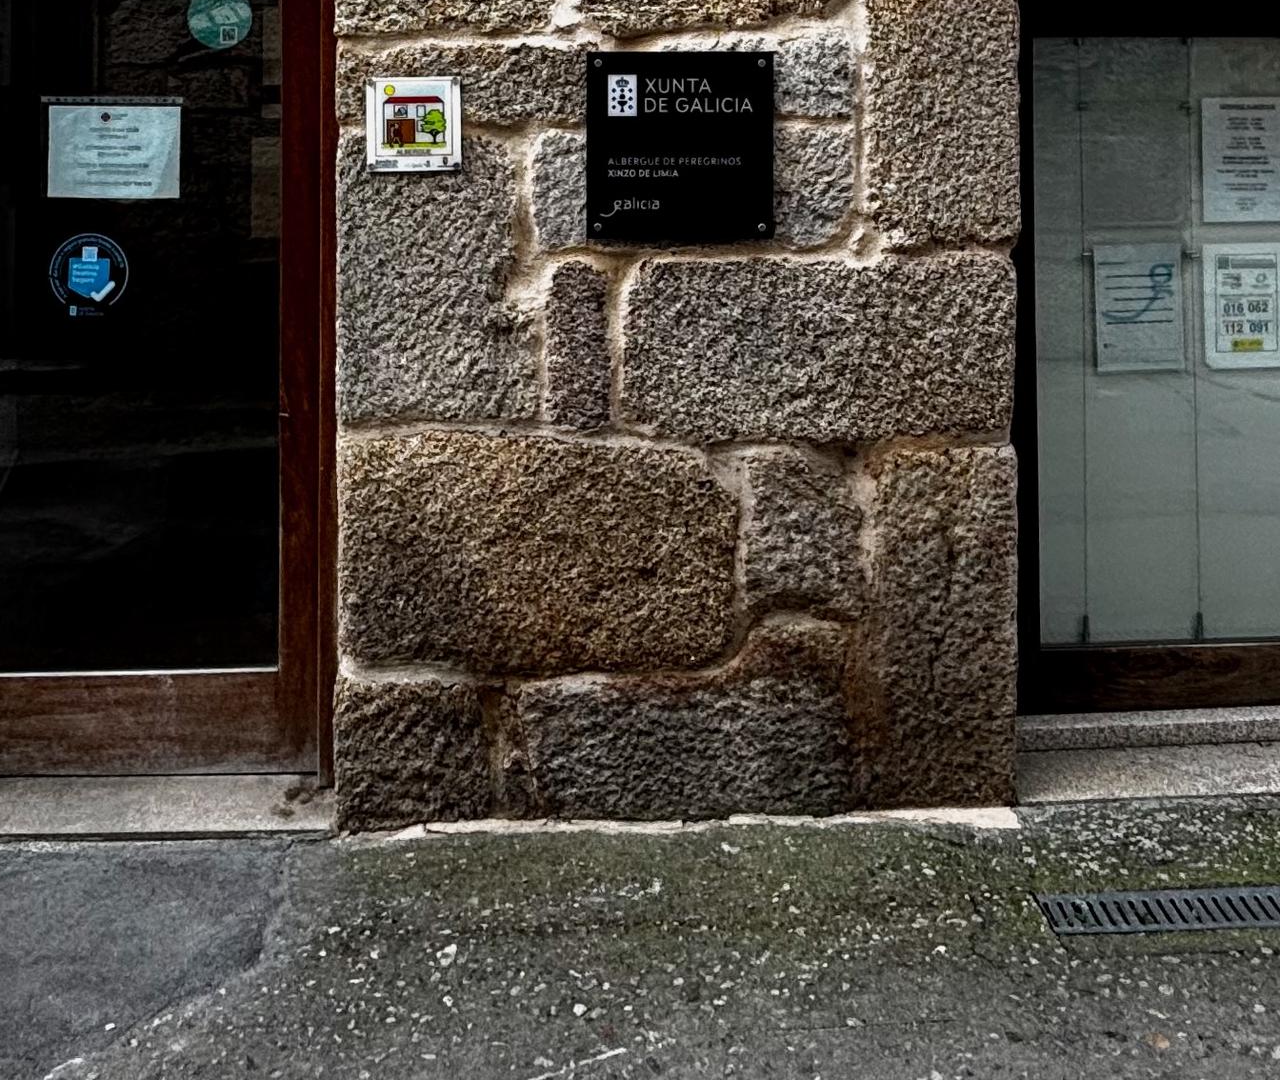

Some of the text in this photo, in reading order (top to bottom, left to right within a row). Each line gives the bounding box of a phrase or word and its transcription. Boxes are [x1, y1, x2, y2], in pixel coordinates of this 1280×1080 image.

[645, 78, 712, 94] XUNTA
[644, 98, 753, 113] DE GALICIA
[608, 157, 742, 166] ALBERGUE DE PEREGRINOS
[638, 169, 651, 178] DE
[600, 196, 660, 217] galicia
[1223, 301, 1268, 314] 016 062
[1224, 322, 1269, 334] 112 091
